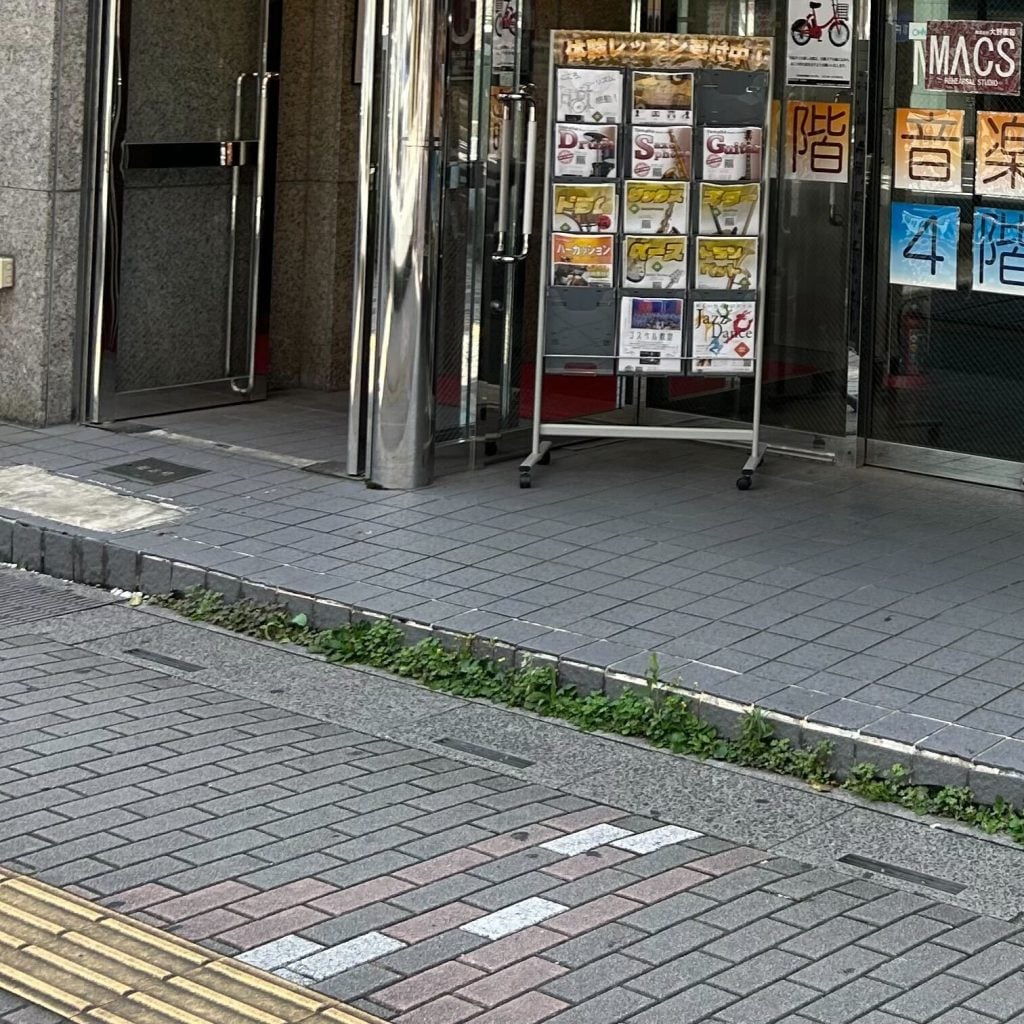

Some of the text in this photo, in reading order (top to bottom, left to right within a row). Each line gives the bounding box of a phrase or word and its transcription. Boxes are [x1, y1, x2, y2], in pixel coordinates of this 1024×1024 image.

[929, 35, 1016, 78] MACS
[977, 79, 999, 87] STUDIO
[696, 308, 731, 328] Jazz
